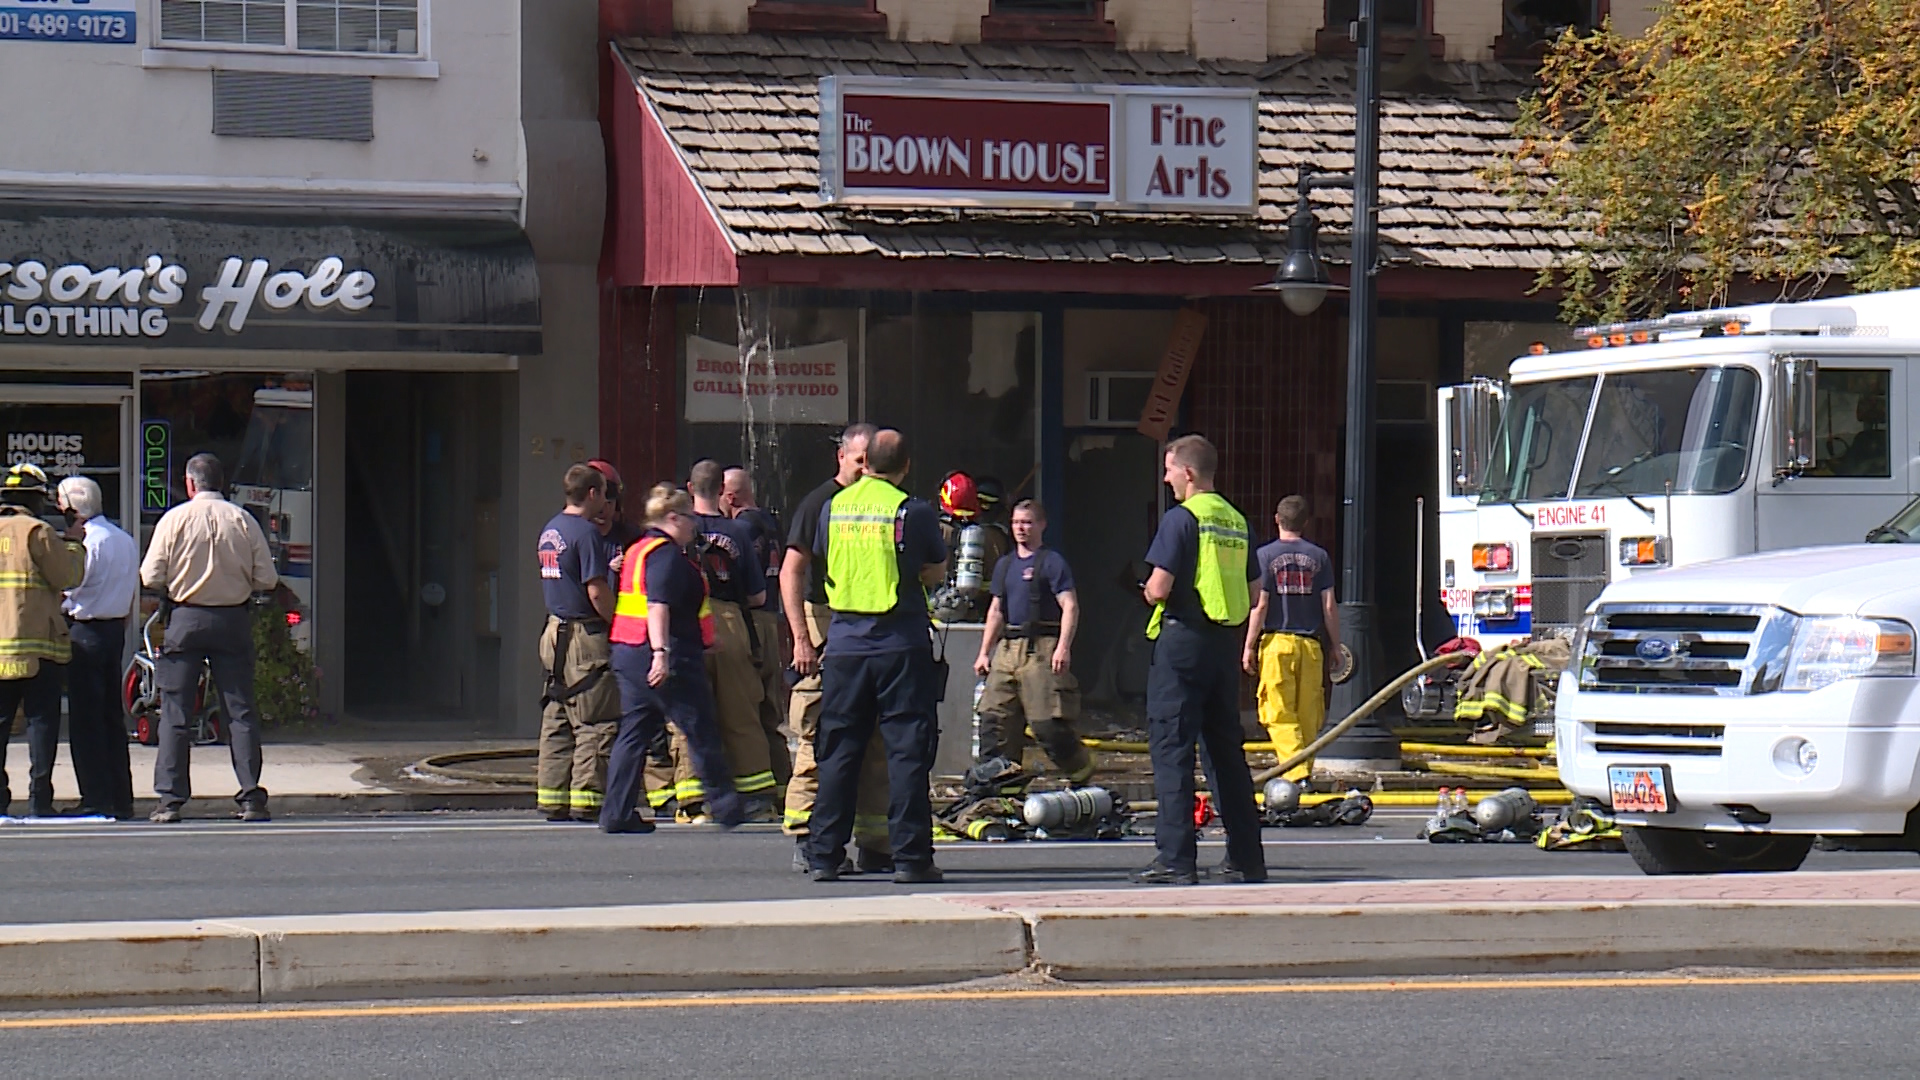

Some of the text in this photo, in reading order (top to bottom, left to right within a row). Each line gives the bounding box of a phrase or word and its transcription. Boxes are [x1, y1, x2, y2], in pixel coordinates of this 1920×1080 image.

[844, 113, 872, 133] The
[1150, 103, 1226, 148] Fine
[845, 134, 1106, 185] BROWN HOUSE
[1145, 154, 1232, 199] Arts
[199, 255, 376, 333] Hole
[773, 363, 836, 377] HOUSE
[7, 433, 83, 451] HOURS
[145, 425, 166, 509] OPEN
[835, 523, 886, 535] SERVICES
[1538, 505, 1605, 526] ENGINE 41
